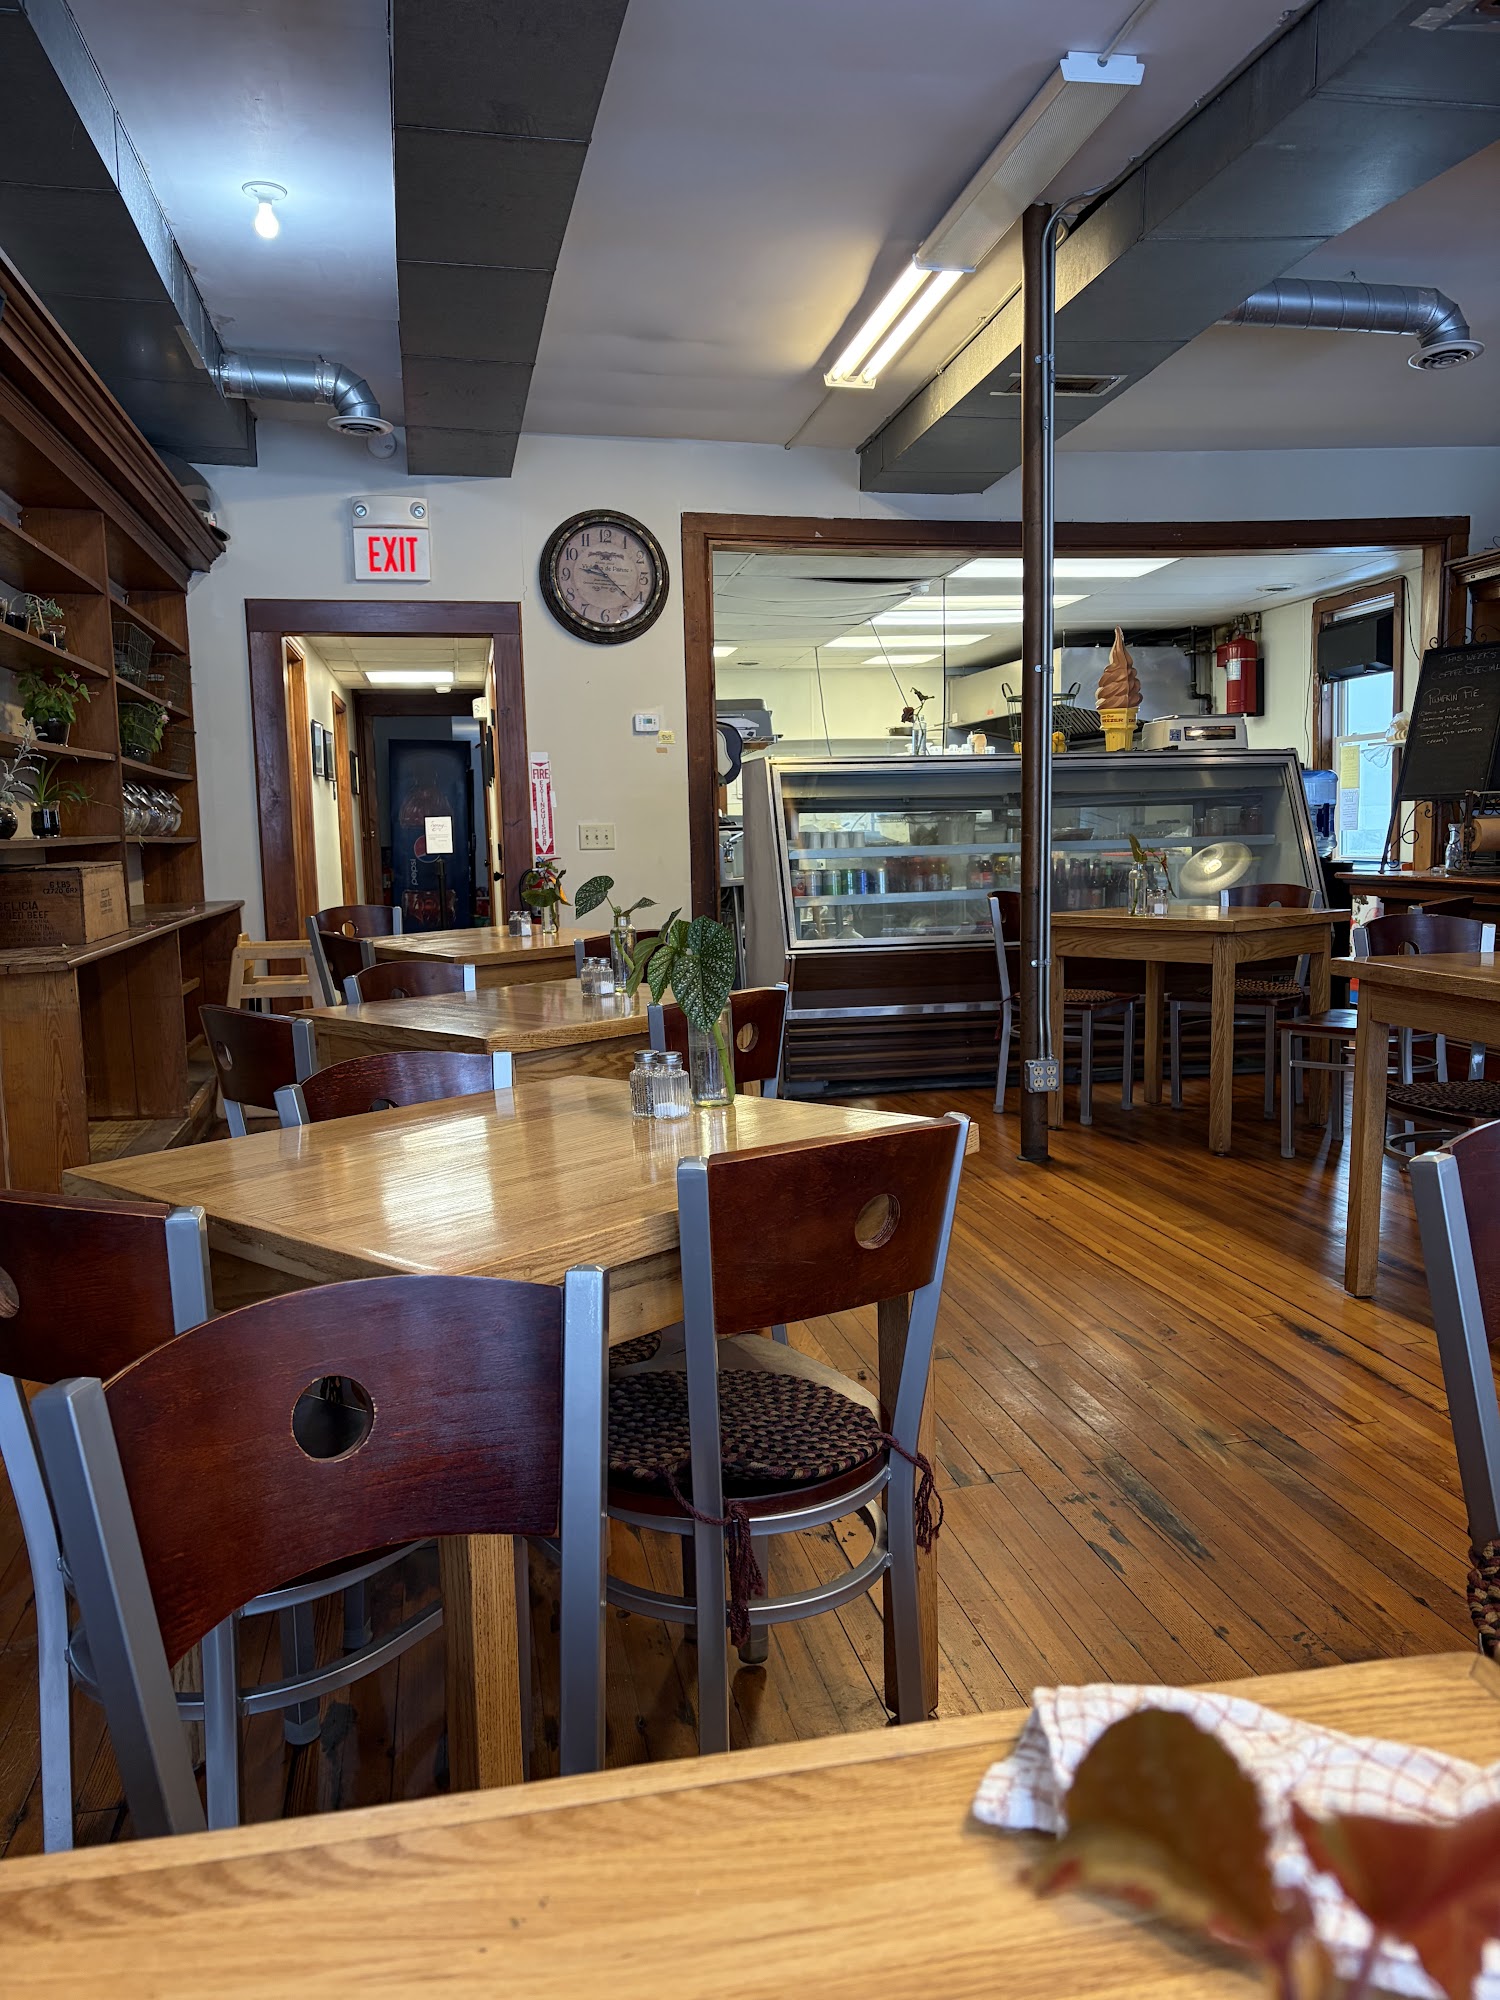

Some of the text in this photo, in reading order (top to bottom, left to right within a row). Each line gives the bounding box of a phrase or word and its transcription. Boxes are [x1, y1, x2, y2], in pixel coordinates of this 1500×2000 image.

[581, 533, 590, 547] 11
[599, 529, 612, 543] 12
[622, 535, 627, 550] 1
[367, 536, 418, 573] EXIT
[565, 547, 578, 561] 10
[636, 550, 645, 565] 2
[561, 567, 571, 581] 9
[639, 571, 649, 586] 3
[566, 587, 575, 602] 8
[632, 591, 645, 605] 4
[580, 603, 590, 617] 7
[600, 609, 610, 623] 6
[619, 605, 629, 619] 5
[1440, 652, 1463, 664] THIS
[1431, 668, 1463, 680] COFFEE
[1424, 686, 1480, 705] PUMPKIN PIE
[532, 768, 549, 780] FIRE
[539, 780, 547, 846] EXTINGUISHER
[410, 858, 419, 886] pepsi
[57, 880, 70, 888] LBS
[27, 910, 49, 919] BEEF
